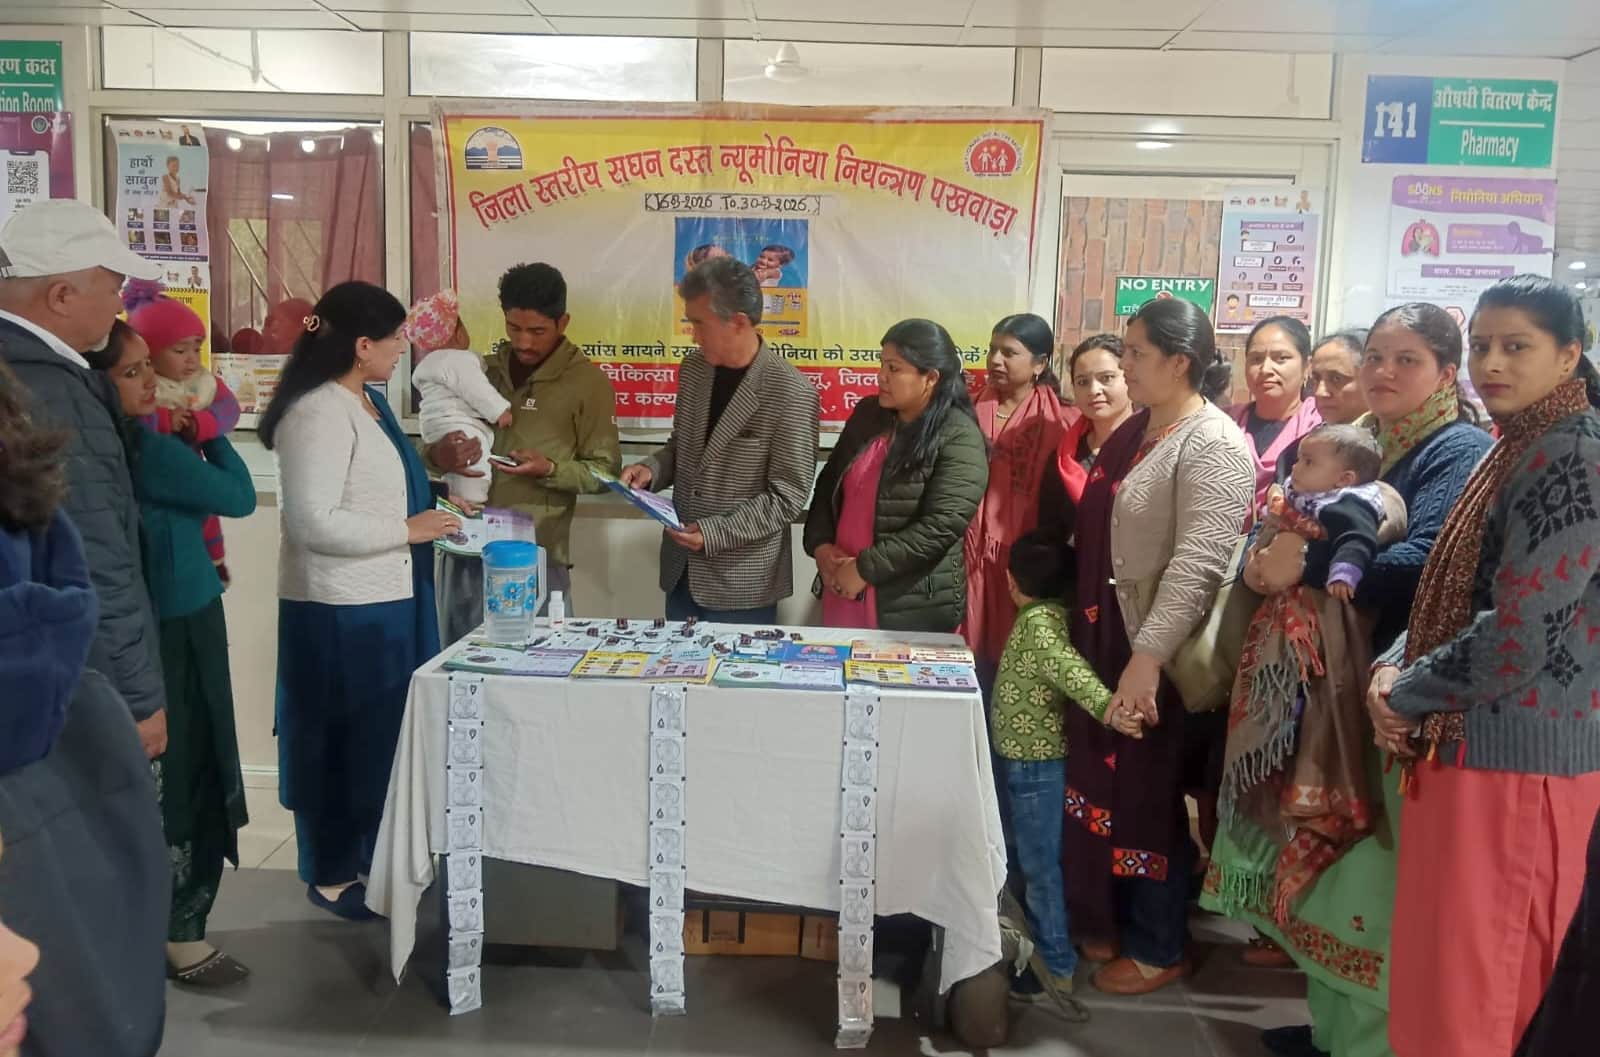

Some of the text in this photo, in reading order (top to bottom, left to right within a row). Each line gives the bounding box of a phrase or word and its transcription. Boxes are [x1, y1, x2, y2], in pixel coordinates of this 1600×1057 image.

[24, 58, 56, 75] कक्ष
[0, 88, 54, 112] ion Room
[1460, 128, 1520, 163] Pharmacy
[468, 190, 533, 230] जिला
[529, 155, 603, 207] स्तरीय
[604, 150, 665, 185] सघन
[667, 144, 713, 176] दस्त
[719, 132, 829, 185] न्यूमोनिया
[833, 143, 928, 202] नियन्त्रण
[930, 177, 1018, 238] पखवाड़ा
[1119, 279, 1210, 292] NO ENTRY
[582, 341, 616, 357] सांस
[622, 341, 665, 358] मायने
[822, 344, 844, 360] को
